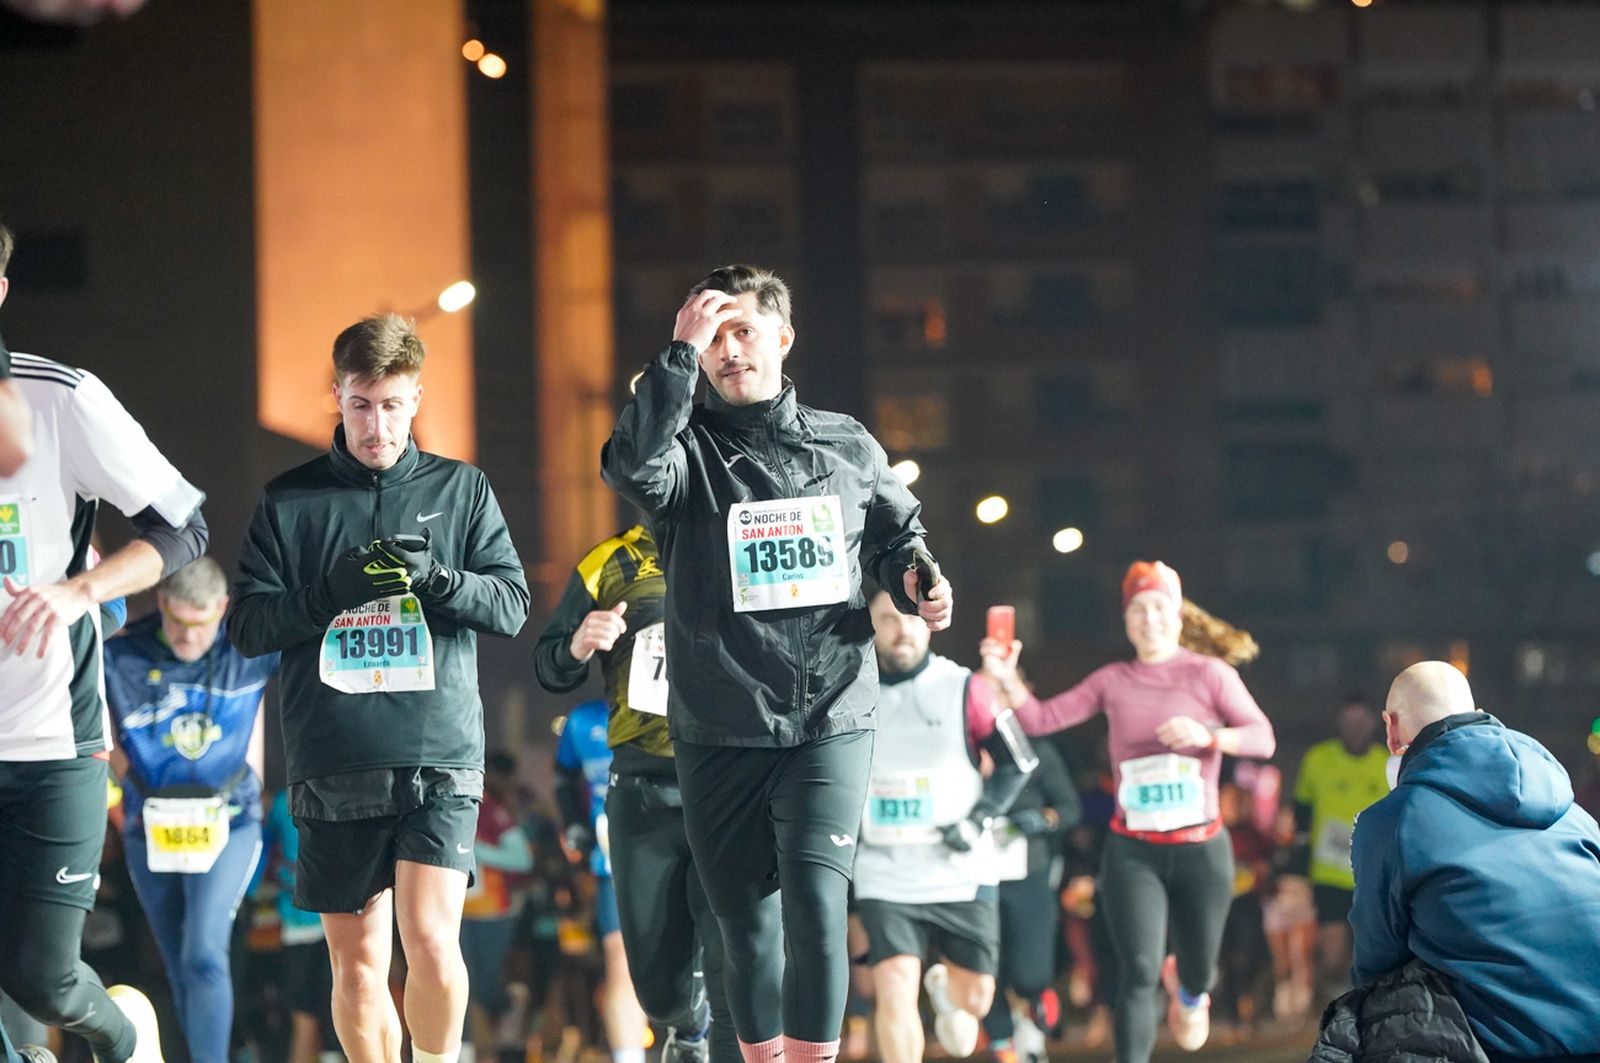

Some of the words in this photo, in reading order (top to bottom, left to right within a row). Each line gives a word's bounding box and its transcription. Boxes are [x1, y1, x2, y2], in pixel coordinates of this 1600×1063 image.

[754, 512, 789, 524] NOCHE
[790, 511, 802, 521] DE
[741, 527, 765, 540] SAN
[743, 535, 834, 574] 13589
[377, 602, 391, 612] DE
[333, 616, 354, 628] SAN
[355, 612, 391, 627] ANTÓN
[335, 626, 418, 659] 13991
